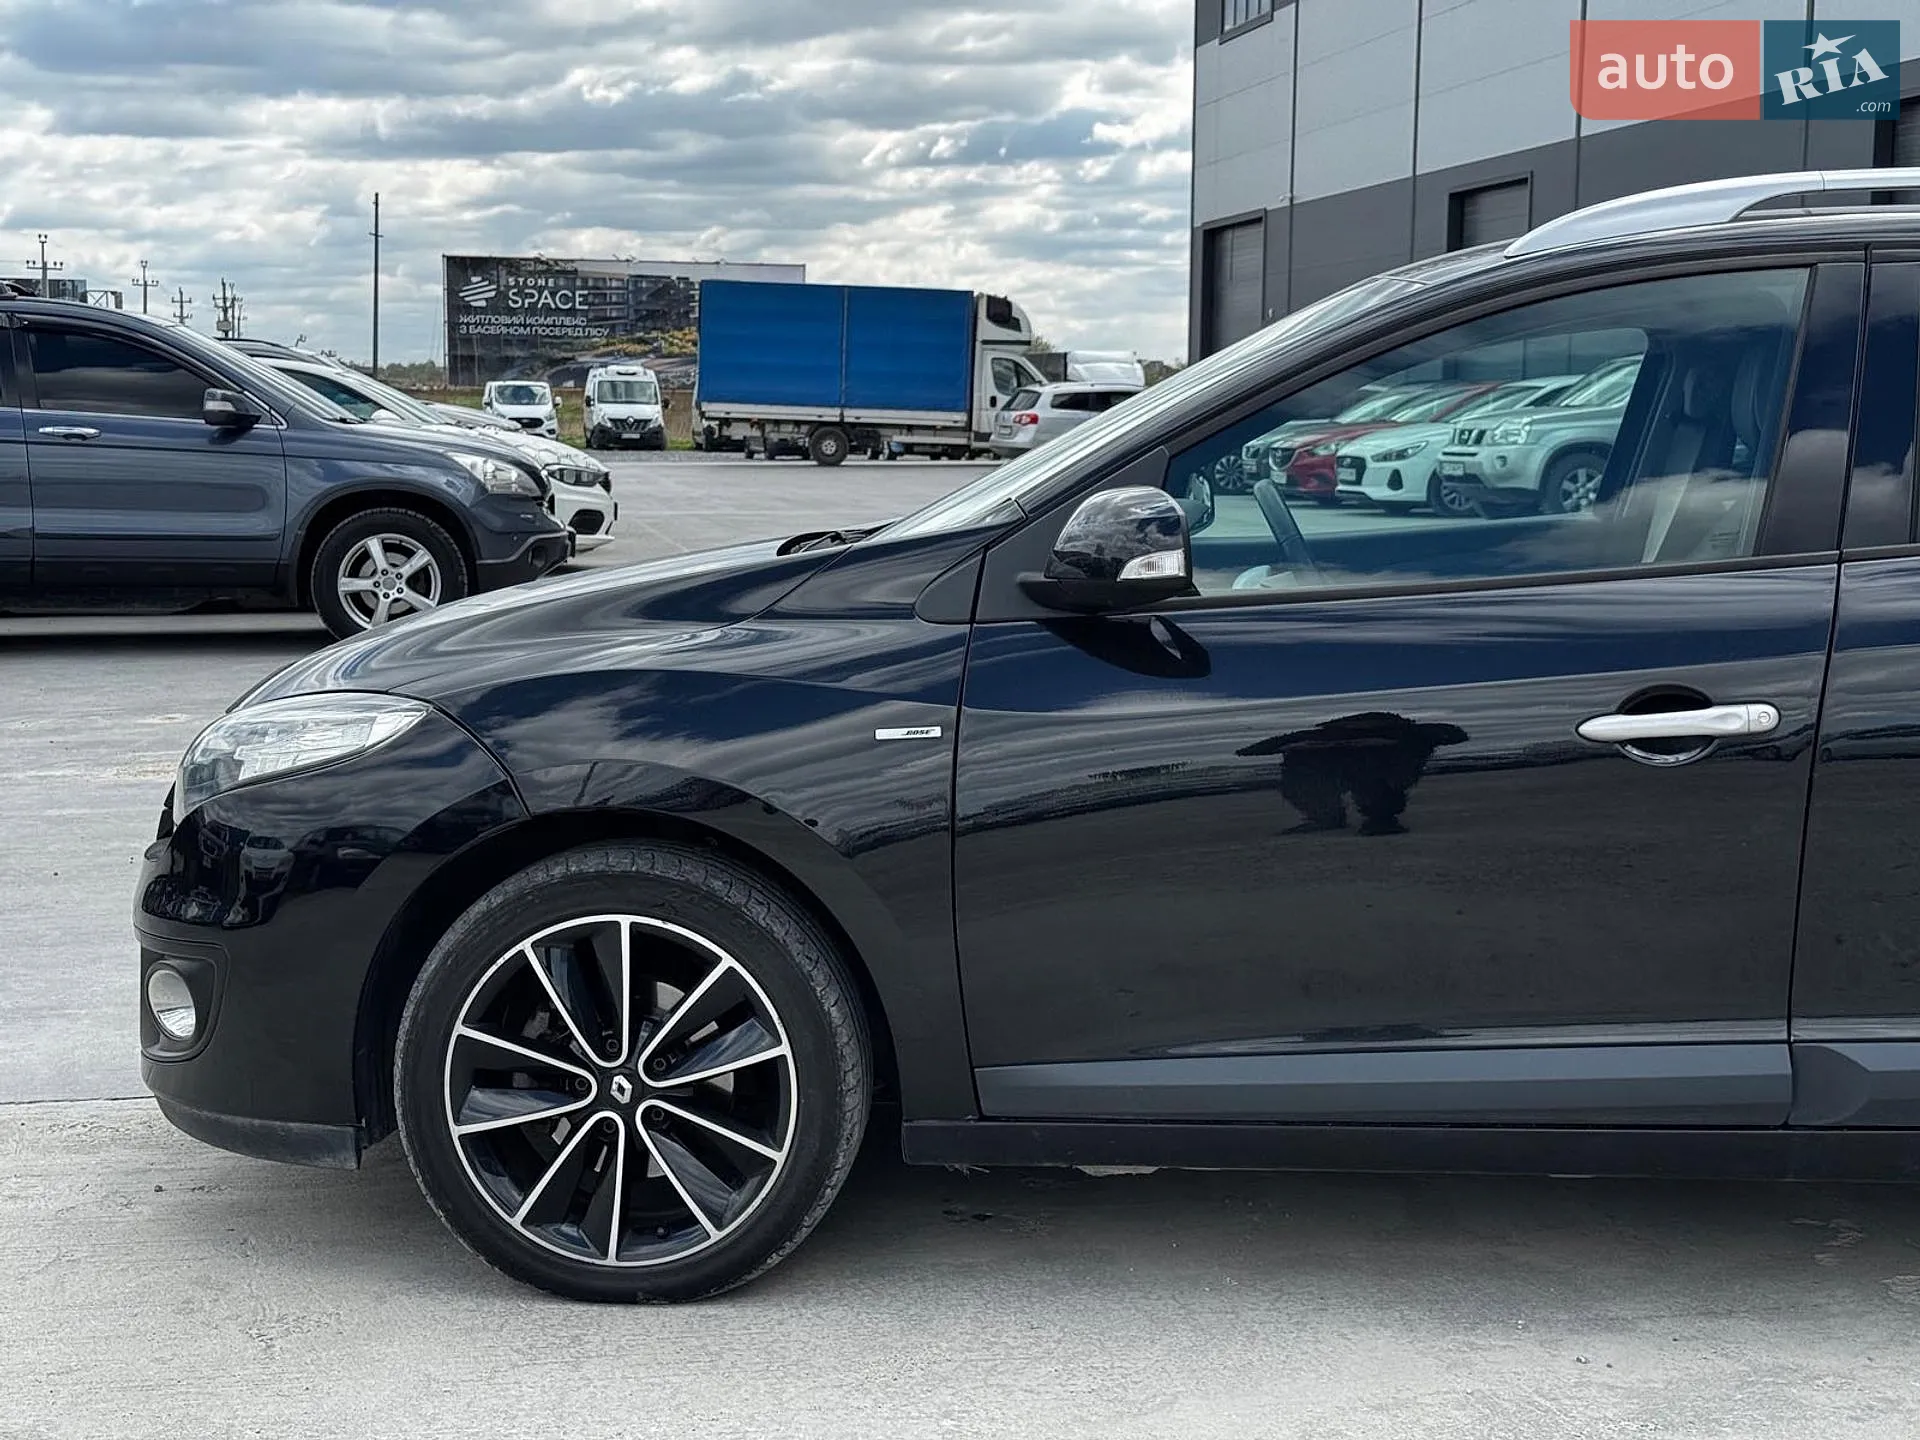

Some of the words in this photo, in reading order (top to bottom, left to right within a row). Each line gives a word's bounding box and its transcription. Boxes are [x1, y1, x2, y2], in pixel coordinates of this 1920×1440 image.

[508, 277, 555, 287] STONE
[508, 288, 589, 310] SPACE
[459, 314, 525, 325] ЖИТЛОВИЙ
[526, 315, 587, 326] КОМПЛЕКС
[469, 325, 532, 335] БАСЕЙНОМ
[532, 326, 584, 336] ПОСЕРЕД
[584, 327, 610, 337] ЛІСУ
